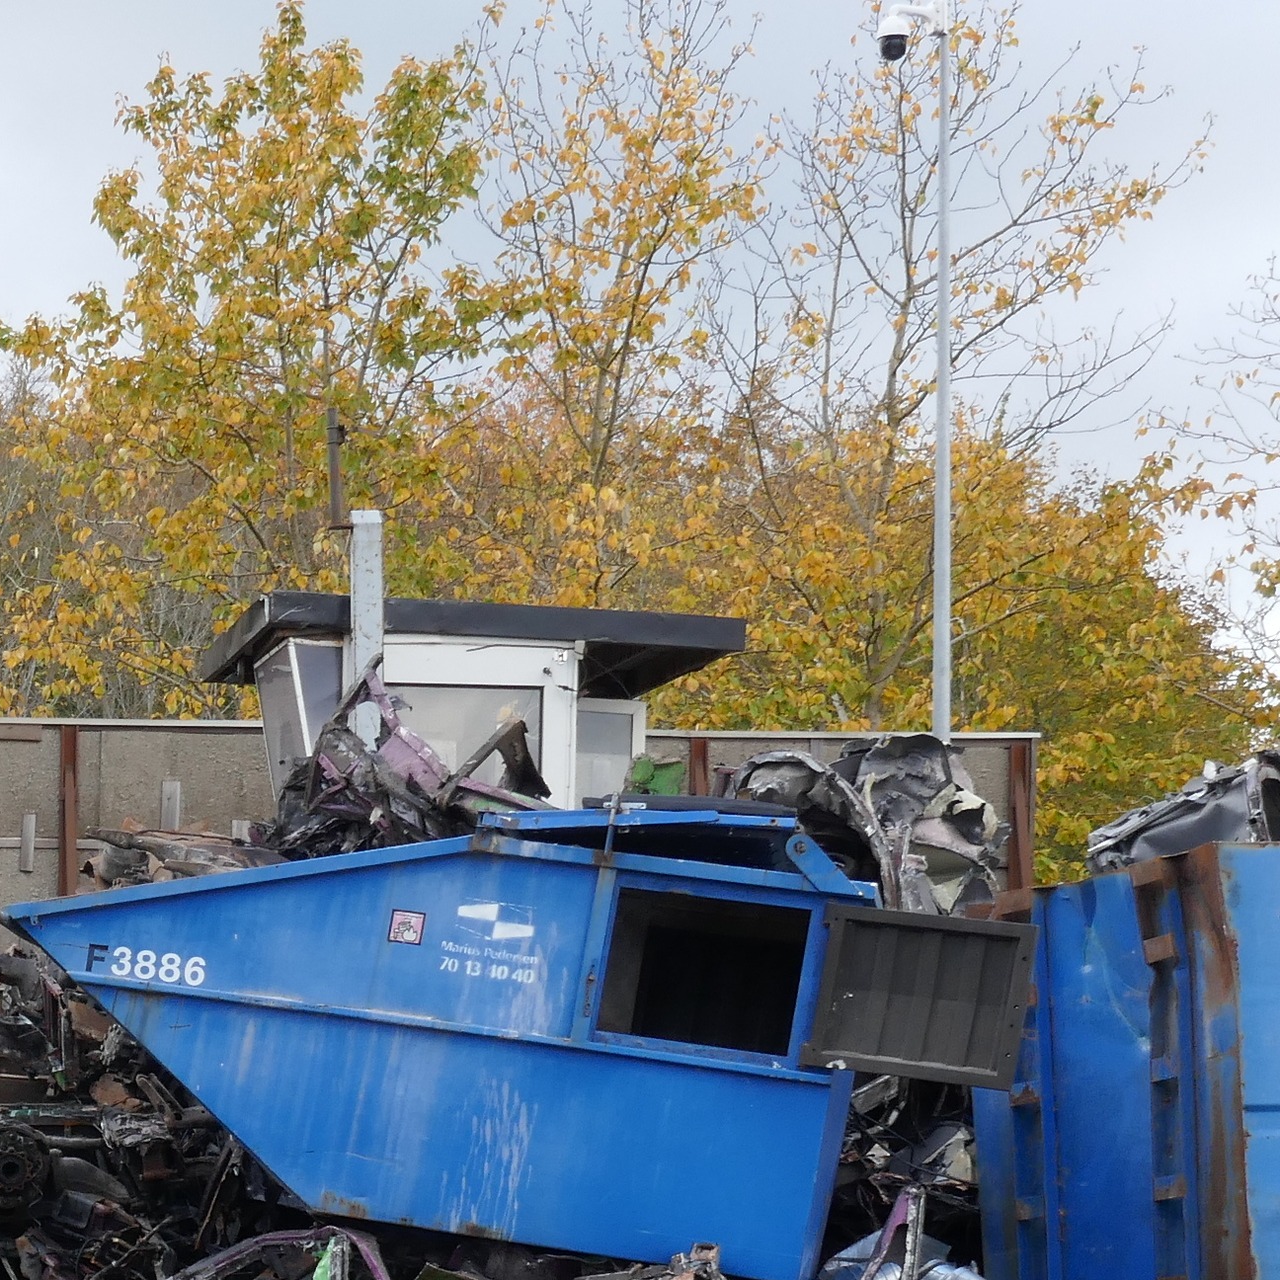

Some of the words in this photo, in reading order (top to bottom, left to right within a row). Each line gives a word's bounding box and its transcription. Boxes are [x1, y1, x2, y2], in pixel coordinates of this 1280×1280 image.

[441, 940, 481, 957] Marius
[484, 947, 539, 965] Pedersen
[439, 956, 459, 973] 70
[464, 960, 482, 977] 13
[511, 968, 535, 984] 40
